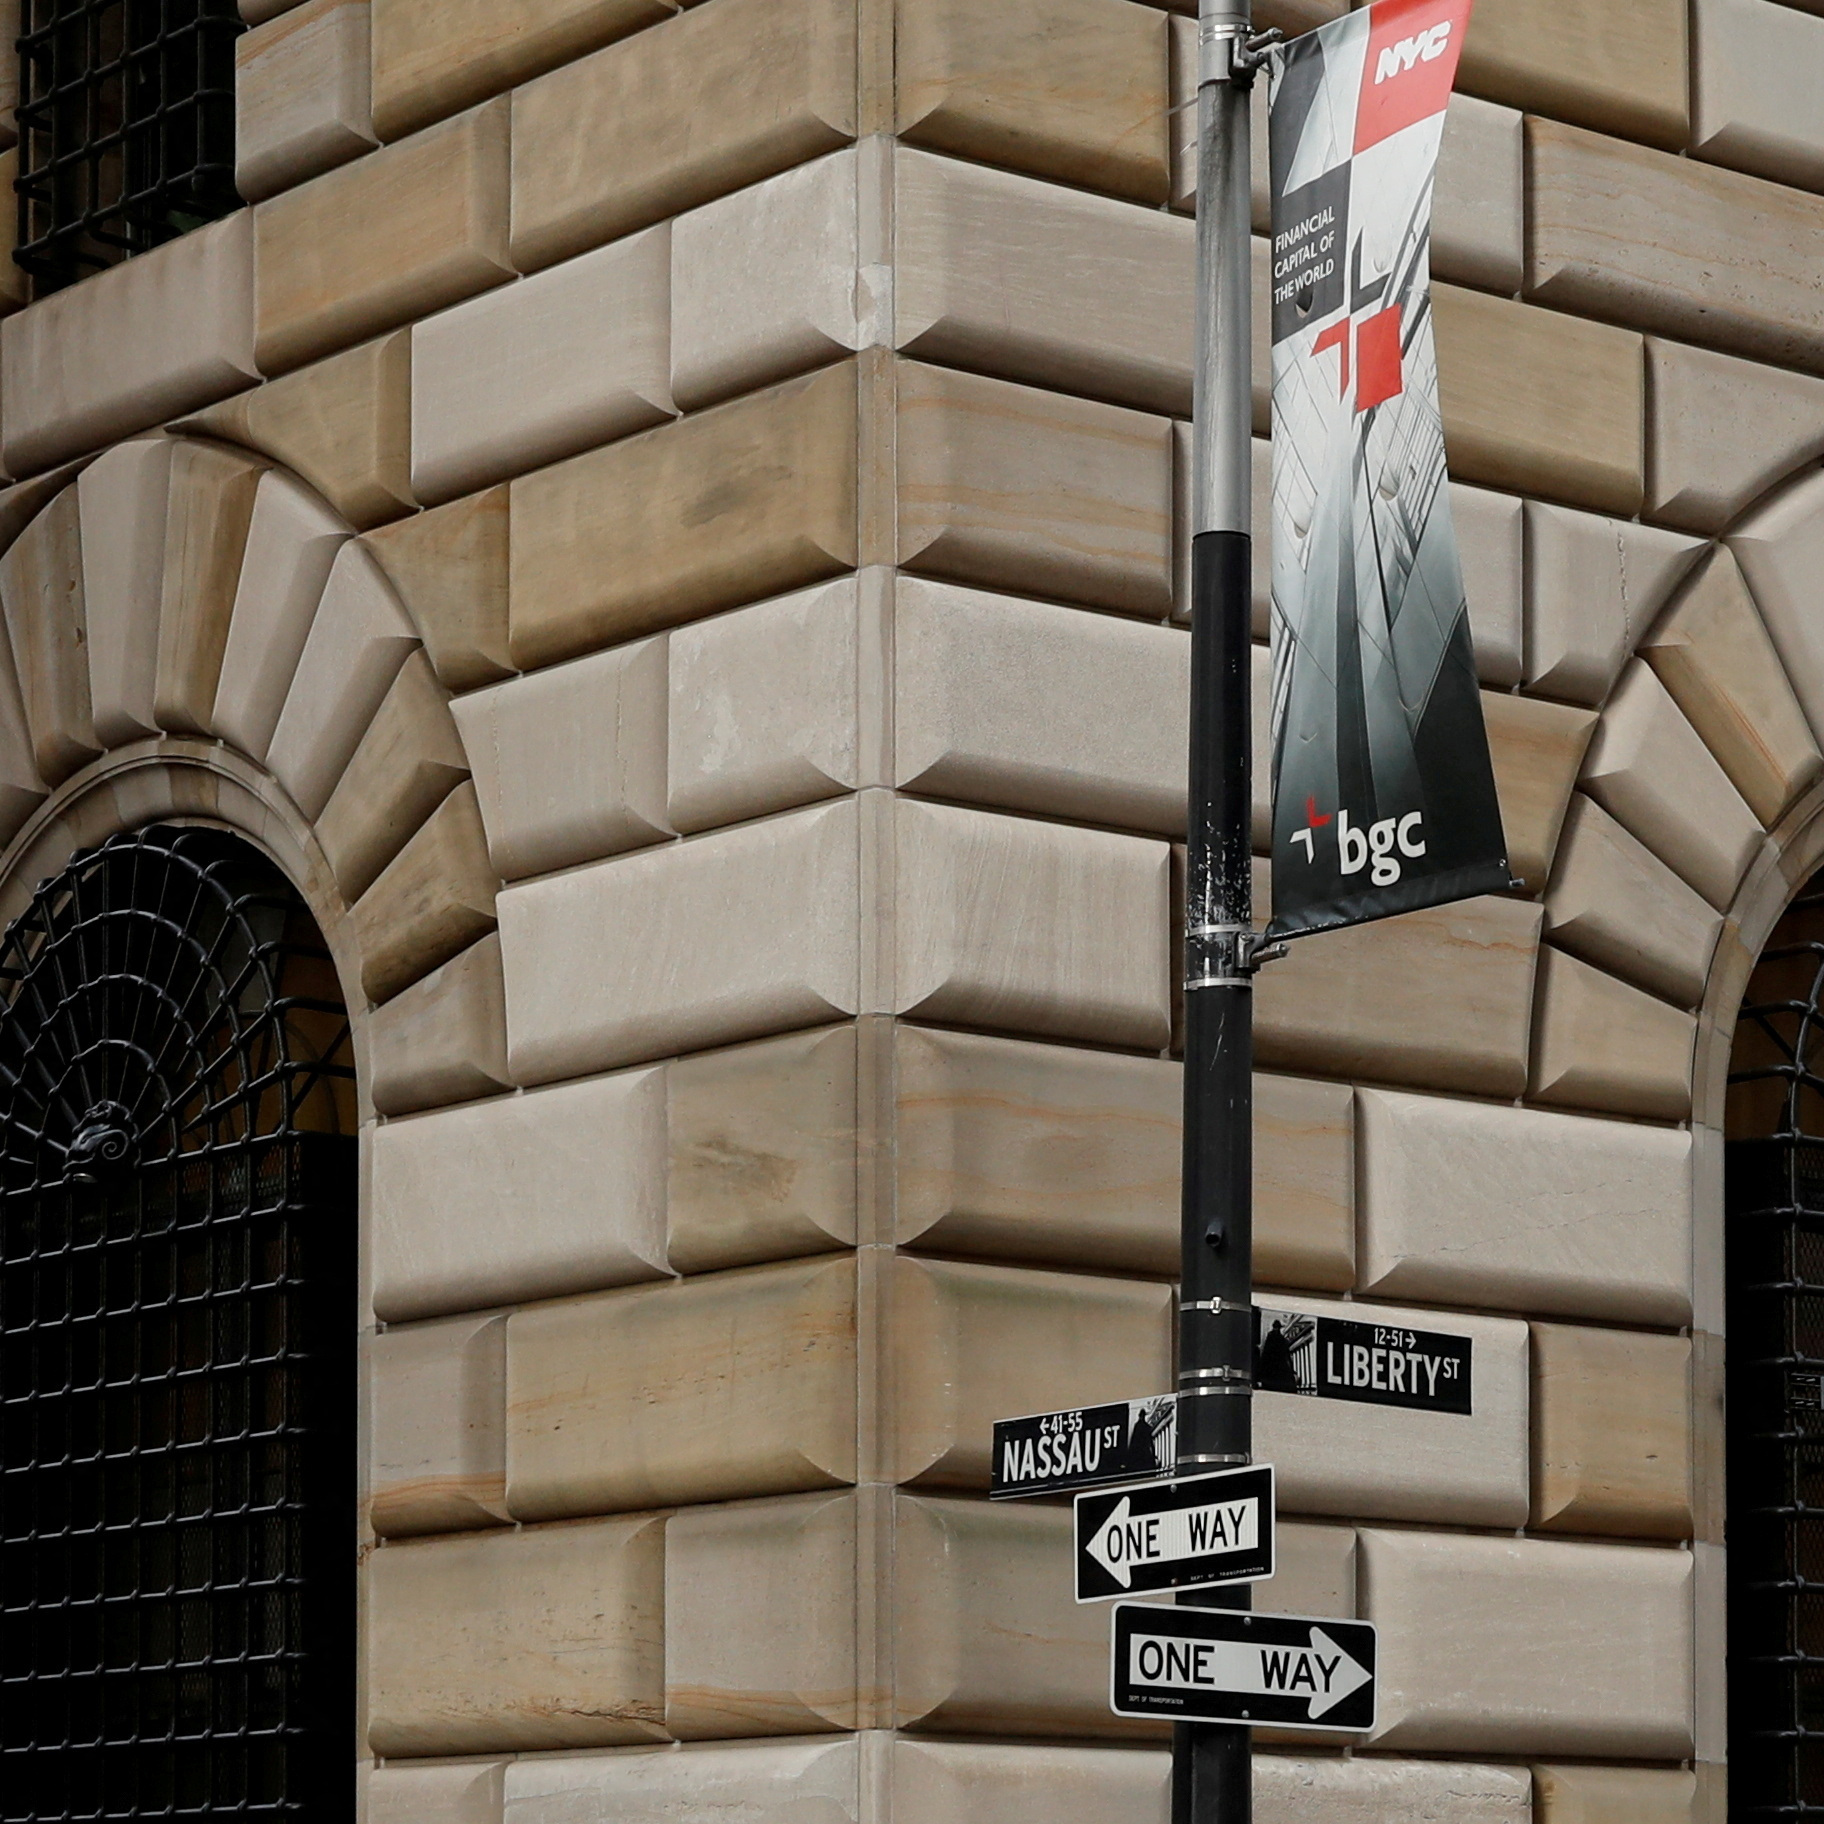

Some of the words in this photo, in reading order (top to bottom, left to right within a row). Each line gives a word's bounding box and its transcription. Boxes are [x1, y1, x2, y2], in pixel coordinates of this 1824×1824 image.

[1374, 20, 1454, 84] NYC
[1274, 242, 1318, 279] CAPITAL
[1319, 230, 1335, 253] OF
[1275, 206, 1335, 254] FINANCIAL
[1274, 280, 1294, 305] THE
[1295, 258, 1334, 292] WORLD
[1336, 809, 1426, 887] bgc
[1374, 1327, 1404, 1348] 12-51
[1326, 1341, 1441, 1397] LIBERTY
[1442, 1356, 1461, 1380] ST
[1050, 1411, 1083, 1435] 41-55
[1002, 1428, 1101, 1483] NASSAU
[1103, 1425, 1121, 1449] ST
[1106, 1518, 1161, 1559] ONE
[1187, 1505, 1247, 1554] WAY
[1138, 1640, 1215, 1685] ONE
[1259, 1650, 1342, 1694] WAY
